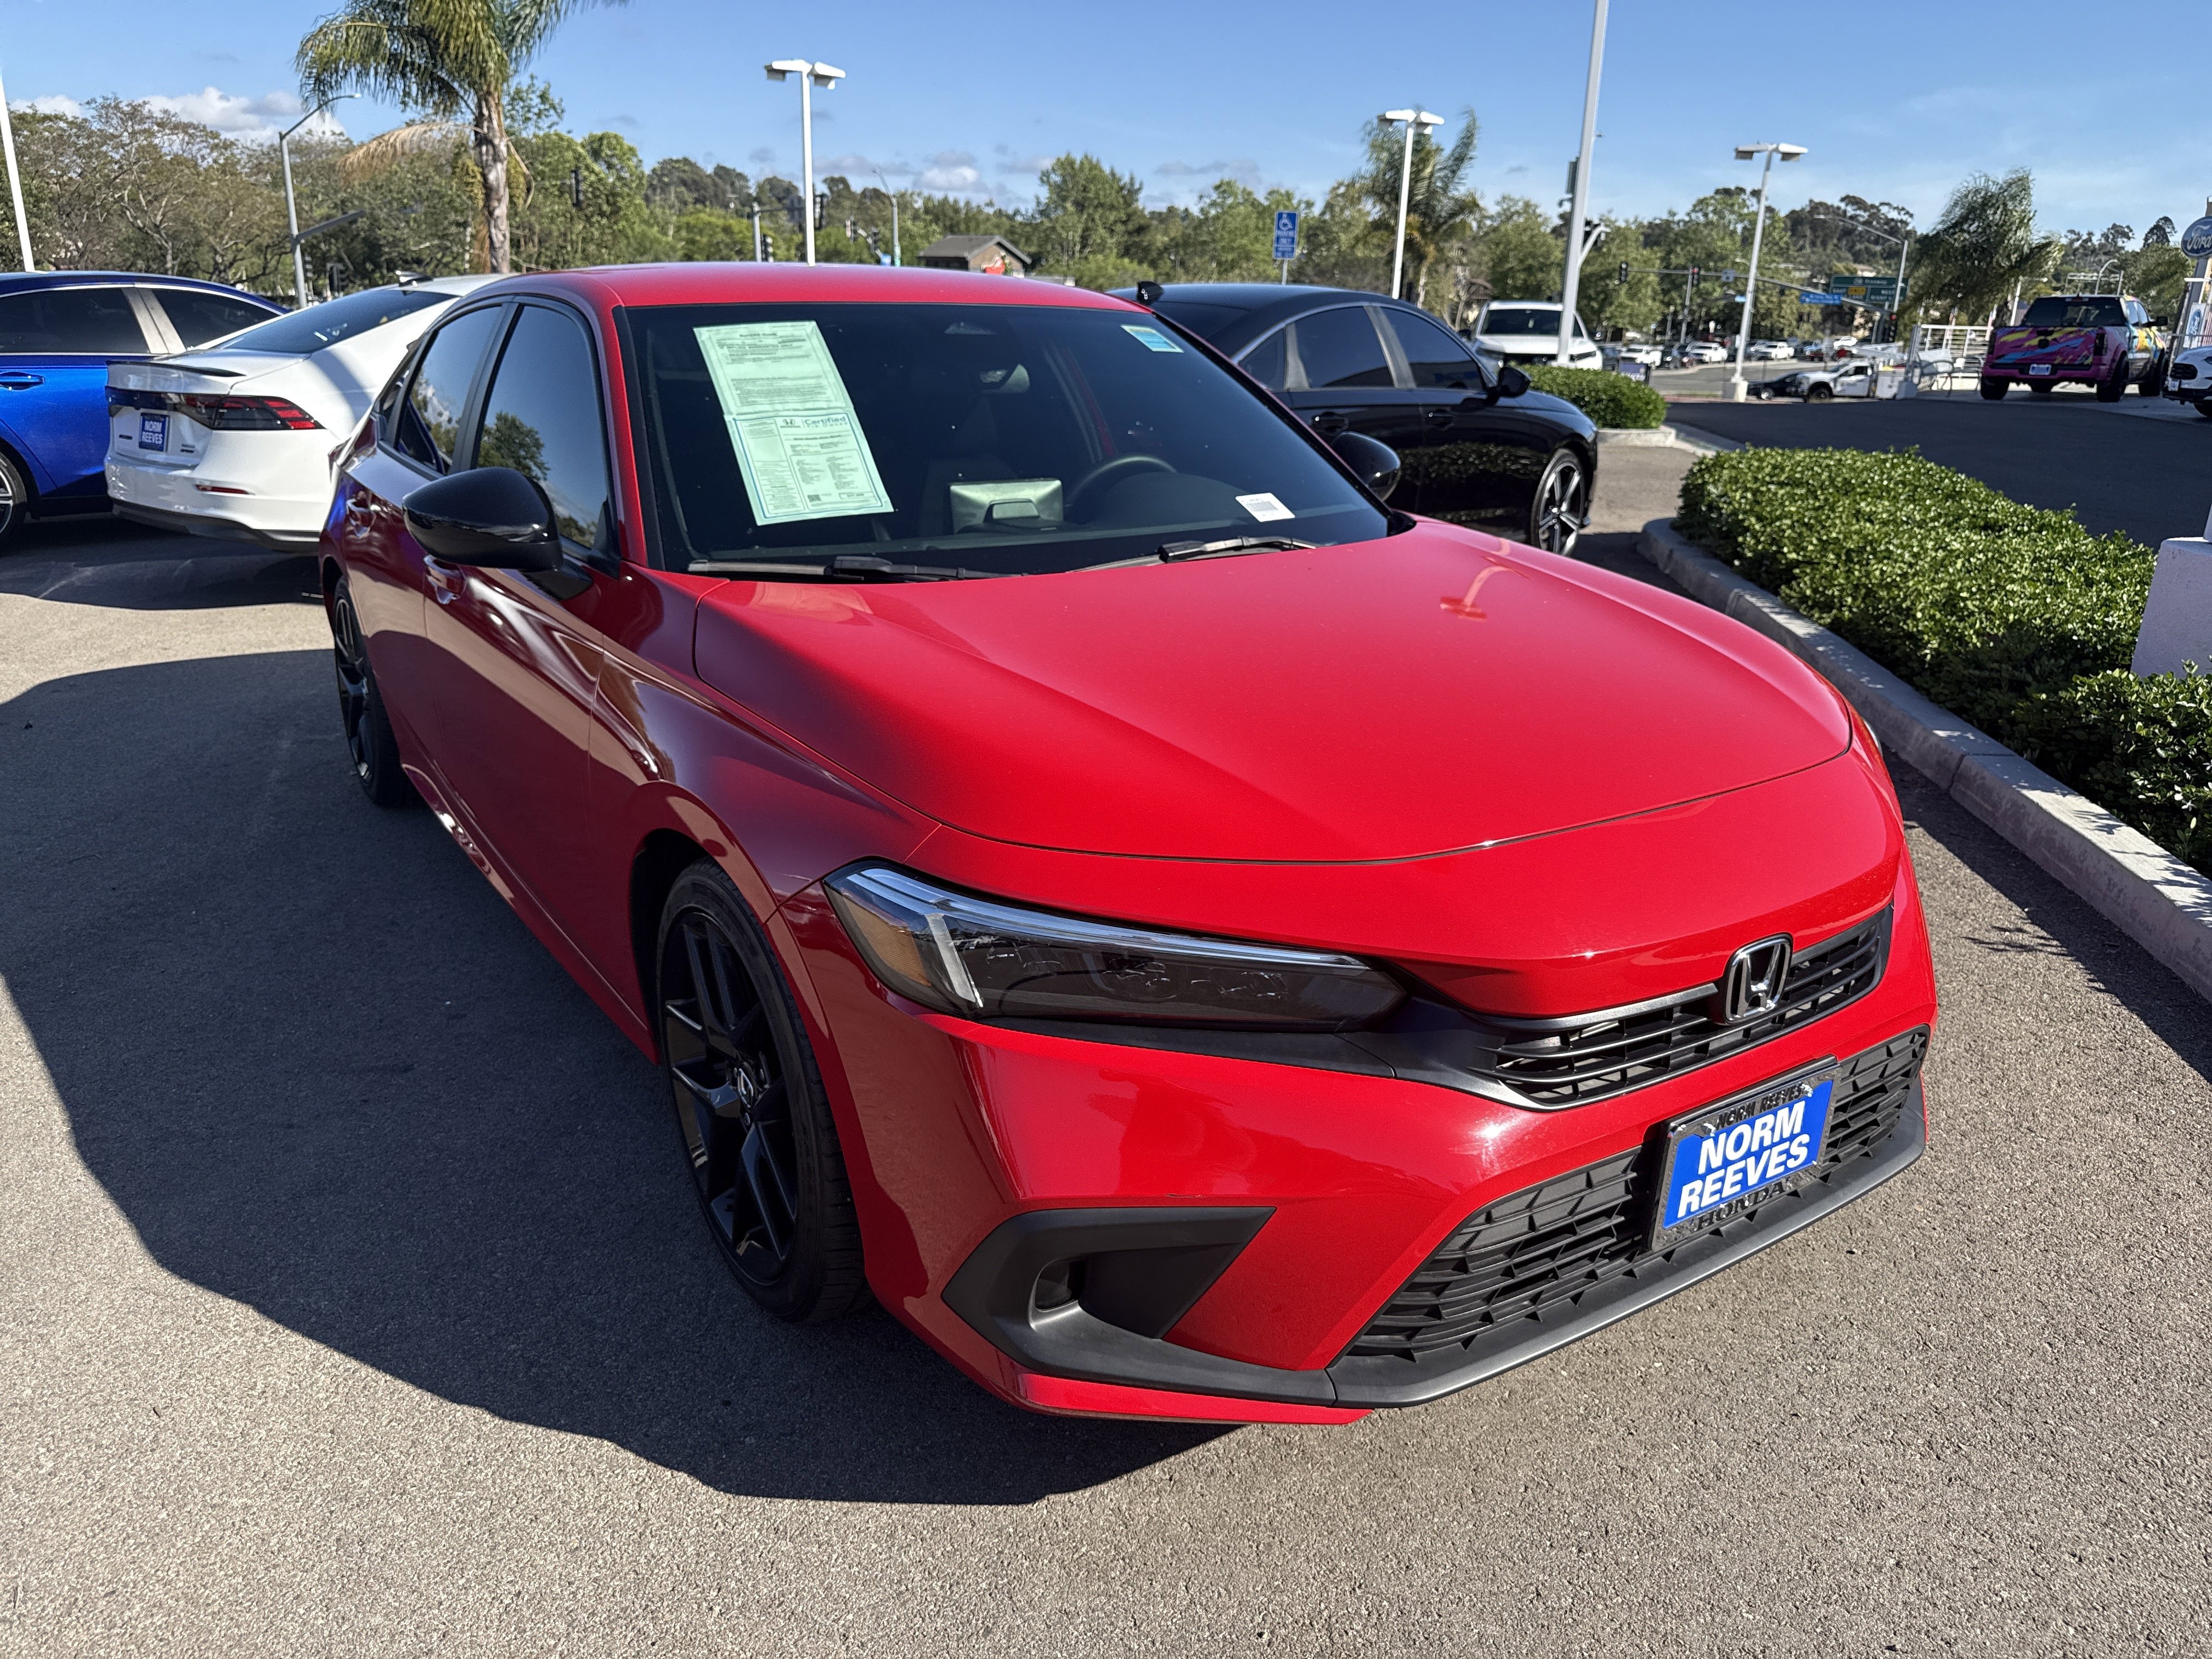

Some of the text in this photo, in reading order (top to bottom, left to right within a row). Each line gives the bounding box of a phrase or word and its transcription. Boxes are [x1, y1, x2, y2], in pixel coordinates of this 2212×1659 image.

[2187, 224, 2212, 250] Ford
[142, 431, 163, 444] REEVES
[145, 421, 162, 432] NORM
[805, 416, 846, 425] Certified
[1716, 1083, 1804, 1128] NORM REEVES
[1698, 1100, 1806, 1175] NORM
[1677, 1133, 1810, 1218] REEVES
[1696, 1181, 1786, 1231] HONDA
